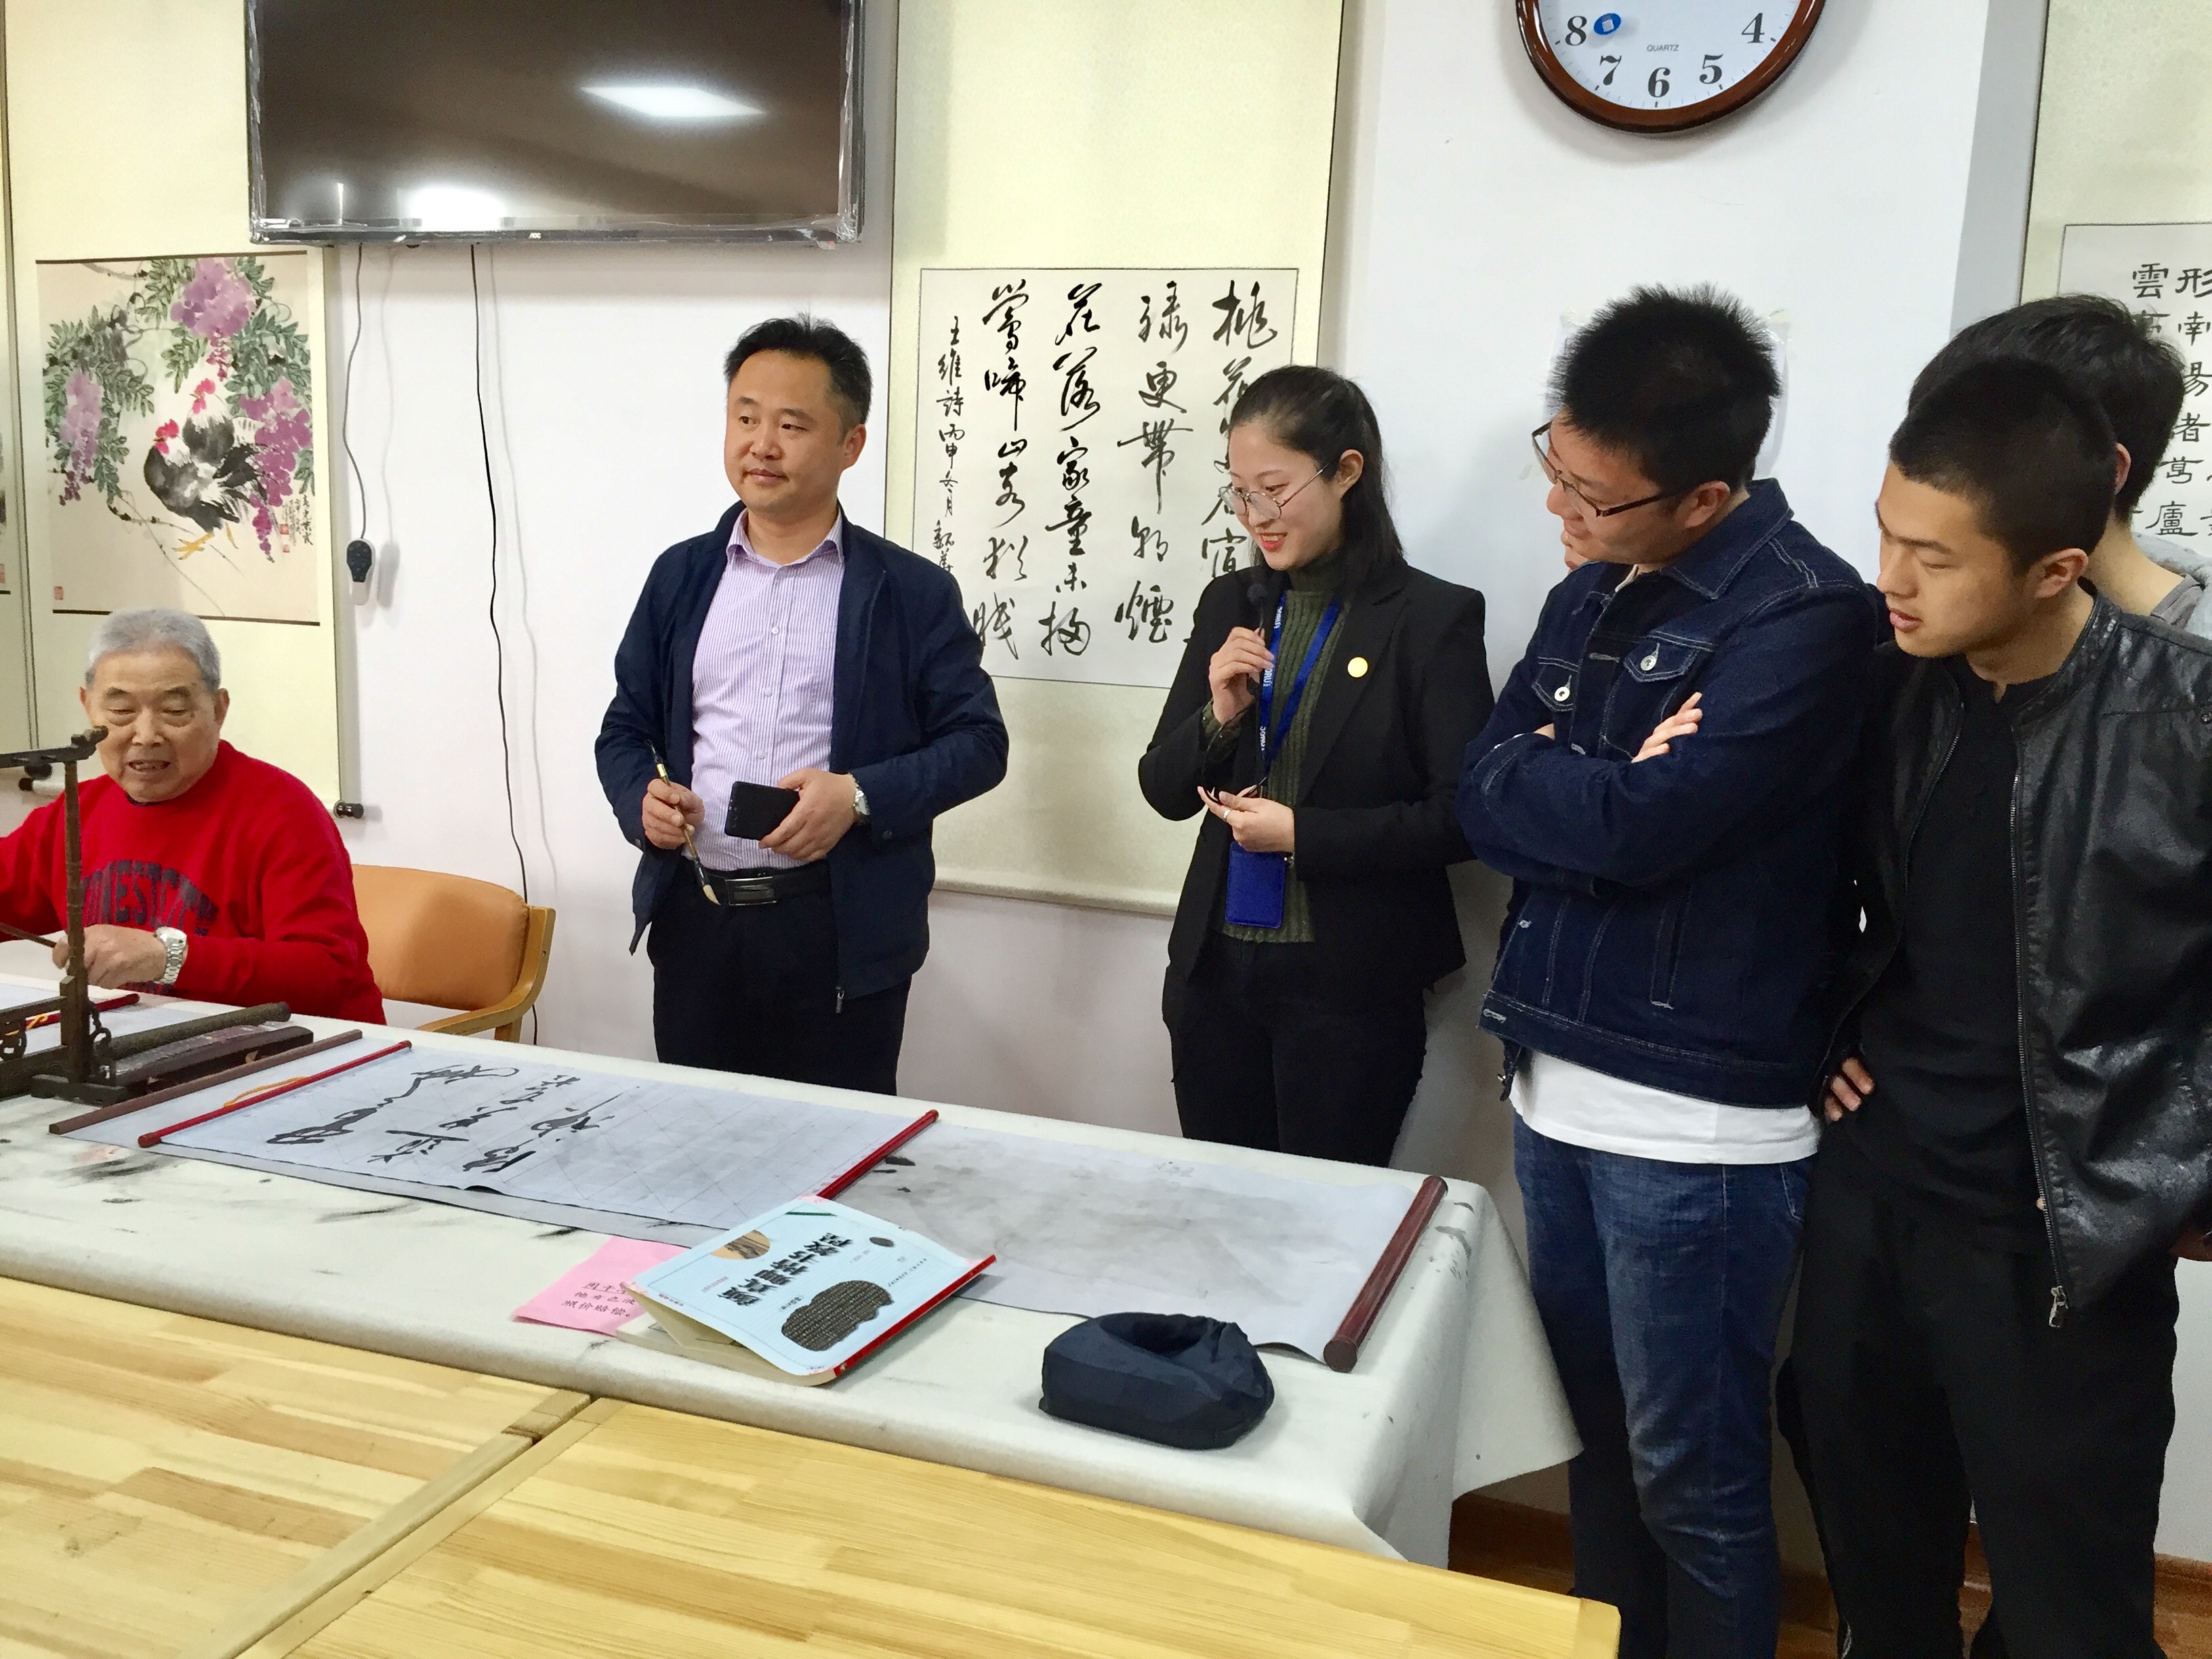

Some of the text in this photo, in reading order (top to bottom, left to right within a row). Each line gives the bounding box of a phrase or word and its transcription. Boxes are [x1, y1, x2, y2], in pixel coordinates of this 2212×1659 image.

[1565, 15, 1588, 46] 8
[1741, 12, 1765, 44] 4
[1647, 44, 1680, 52] QUARTZ
[1599, 55, 1622, 86] 7
[1647, 67, 1671, 98] 6
[1699, 54, 1724, 85] 5
